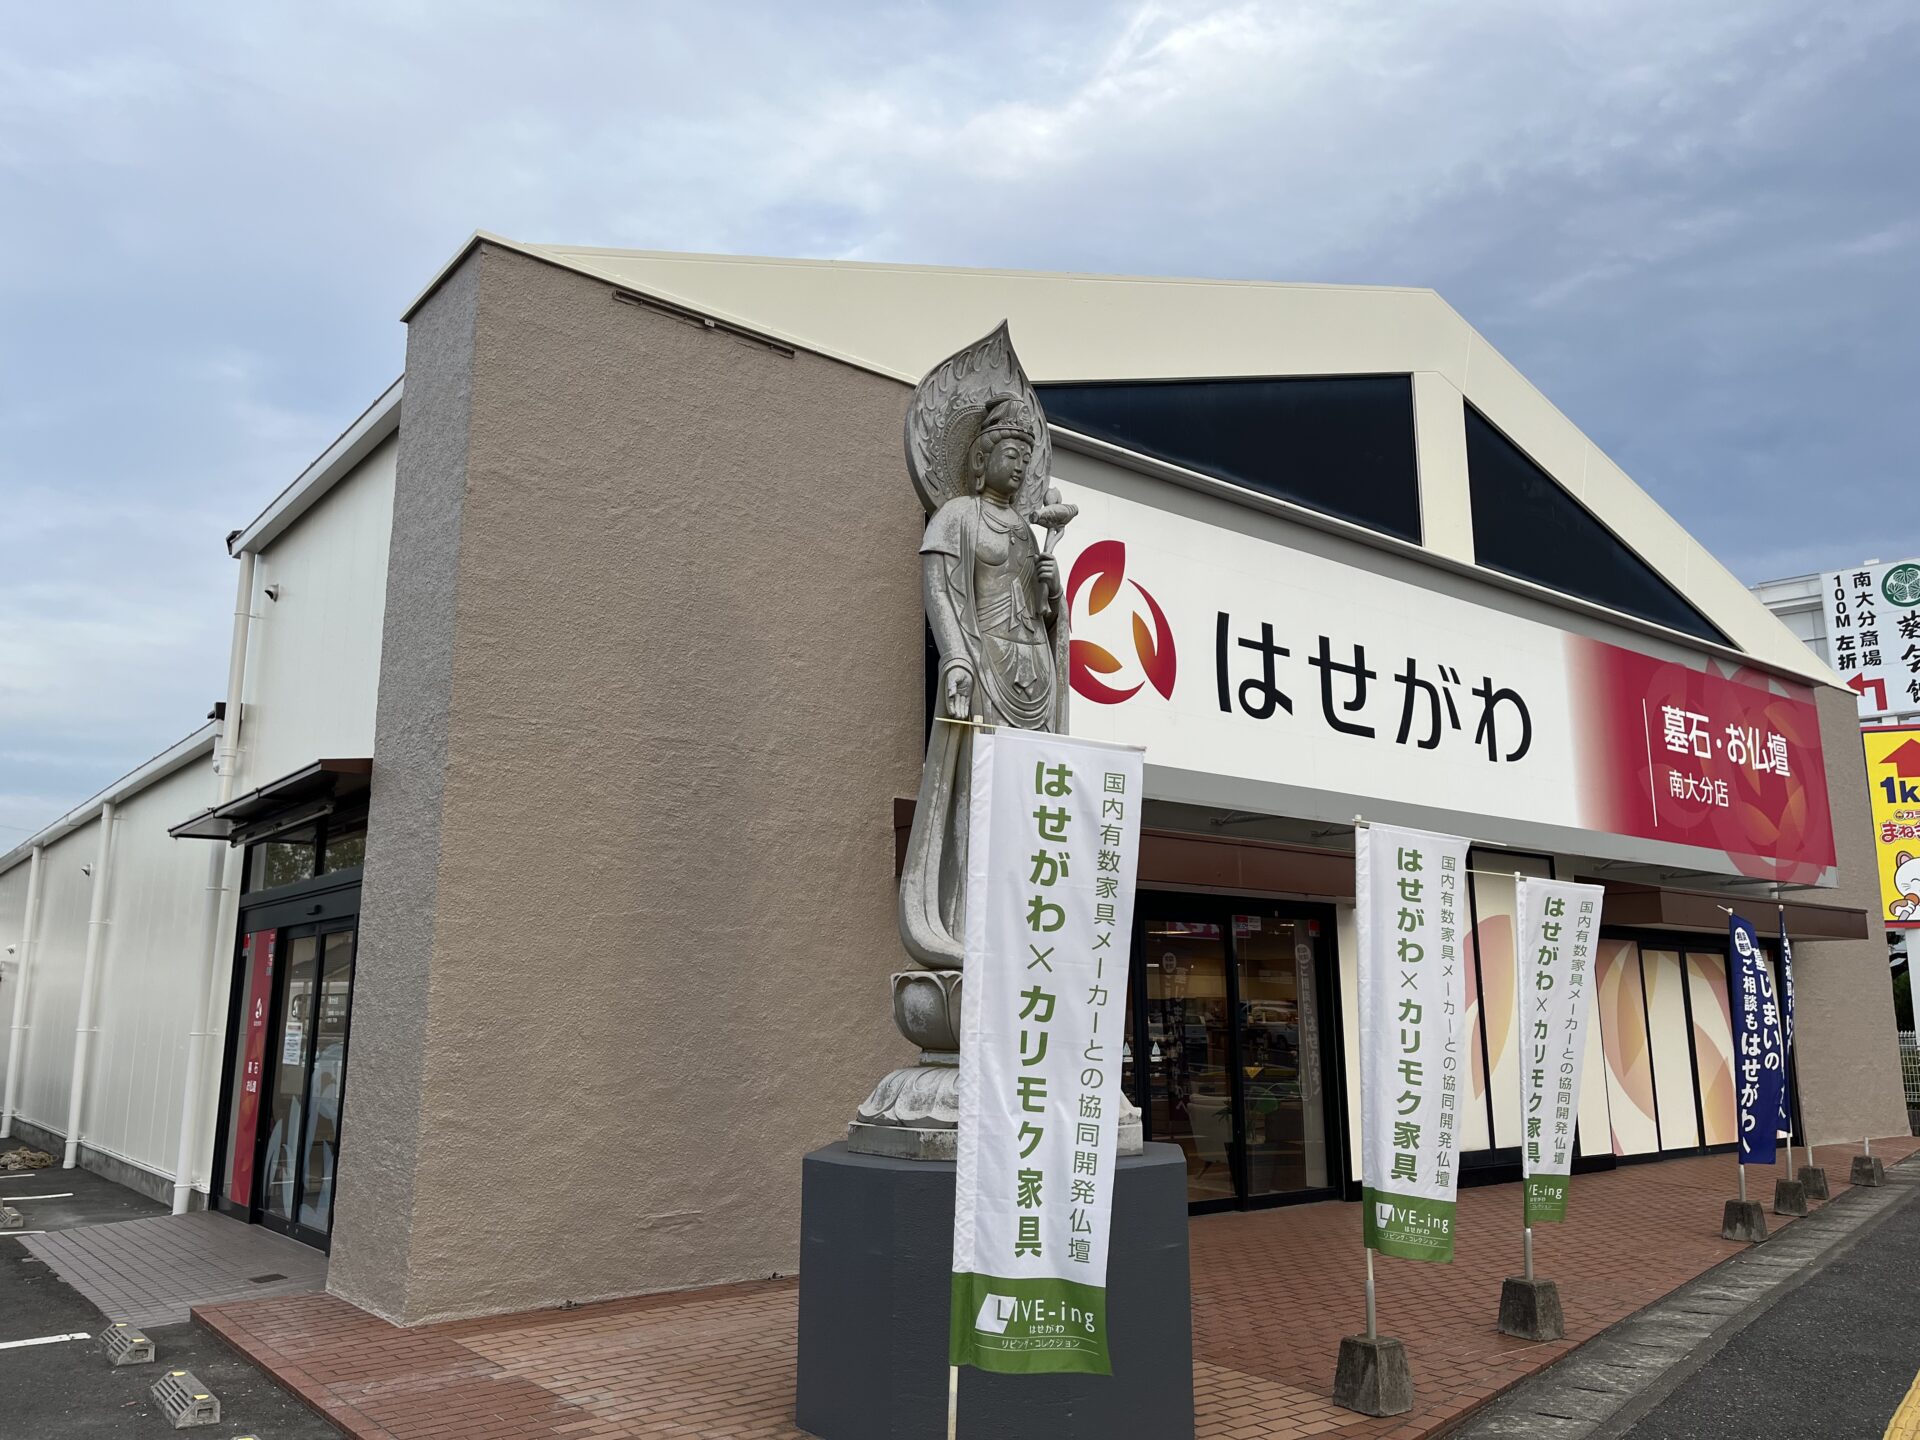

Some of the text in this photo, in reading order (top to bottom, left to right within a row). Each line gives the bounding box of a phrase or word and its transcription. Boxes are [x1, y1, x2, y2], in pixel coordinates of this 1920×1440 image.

[1215, 611, 1532, 763] はせがわ
[1661, 705, 1791, 777] 墓石・お仏壇
[1668, 769, 1729, 807] 南大分店
[1068, 771, 1126, 1264] 国内有数家具メーカーとの協同開発仏壇
[1434, 855, 1457, 1188] 国内有数家具メーカーとの協同開発仏壇
[1380, 1205, 1449, 1234] LIVE-ing
[1404, 1225, 1430, 1235] はせがわ
[996, 1299, 1096, 1333] LIVE-ing
[1029, 1324, 1065, 1334] はせがわ
